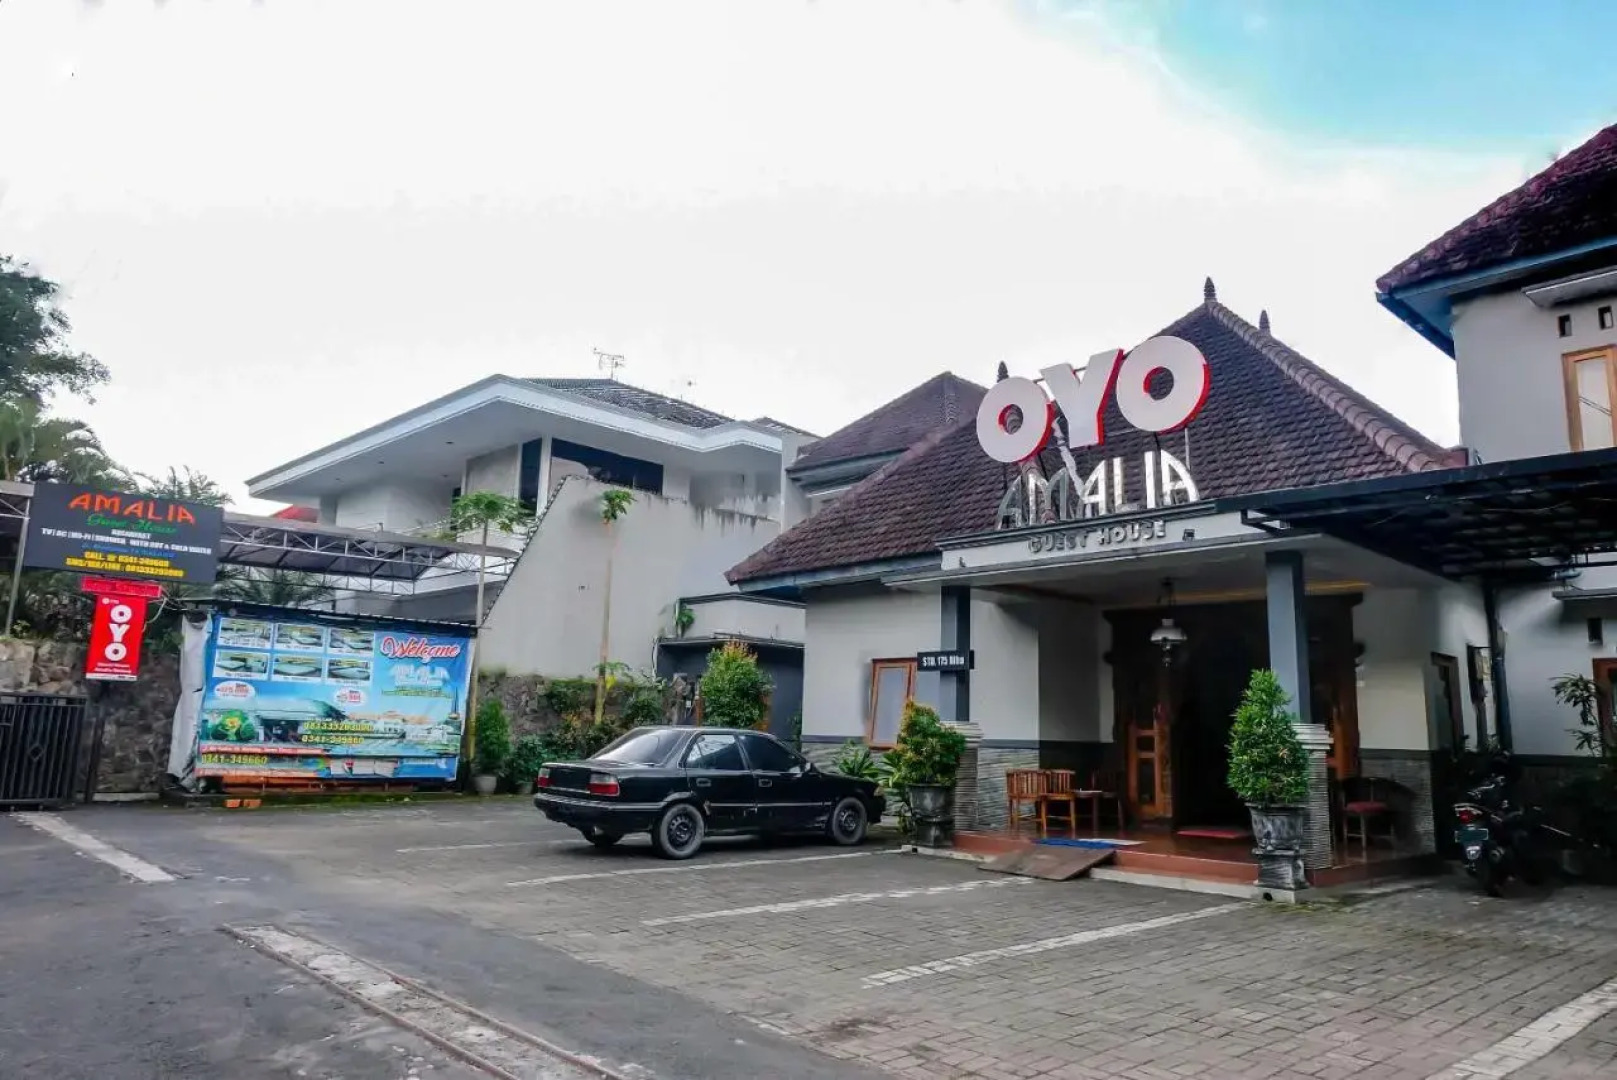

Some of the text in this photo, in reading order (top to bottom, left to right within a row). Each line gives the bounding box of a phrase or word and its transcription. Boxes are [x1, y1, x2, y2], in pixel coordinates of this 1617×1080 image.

[977, 336, 1210, 463] OYO
[68, 492, 196, 524] AMALIA
[996, 449, 1200, 529] AMALIA
[1028, 519, 1166, 554] GUEST HOUSE
[104, 604, 132, 662] OYO
[380, 636, 461, 663] Welcome
